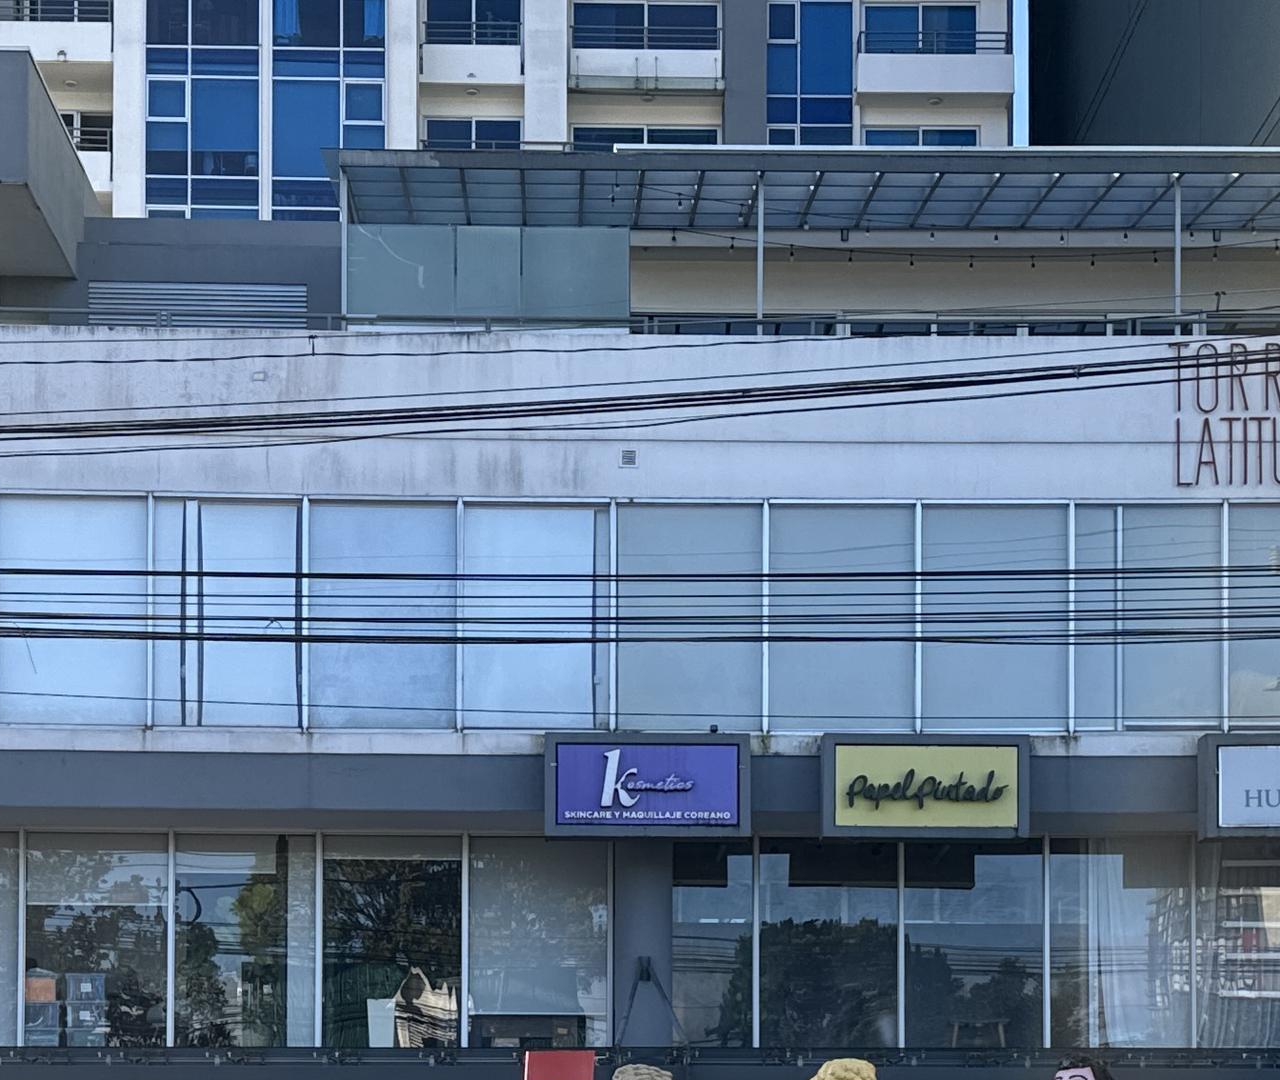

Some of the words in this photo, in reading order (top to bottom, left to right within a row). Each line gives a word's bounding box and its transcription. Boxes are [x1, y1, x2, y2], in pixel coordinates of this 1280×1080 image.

[564, 811, 612, 819] SKINCARE
[614, 811, 620, 819] Y
[622, 811, 682, 820] MAQUILLAJE
[684, 811, 731, 820] COREANO
